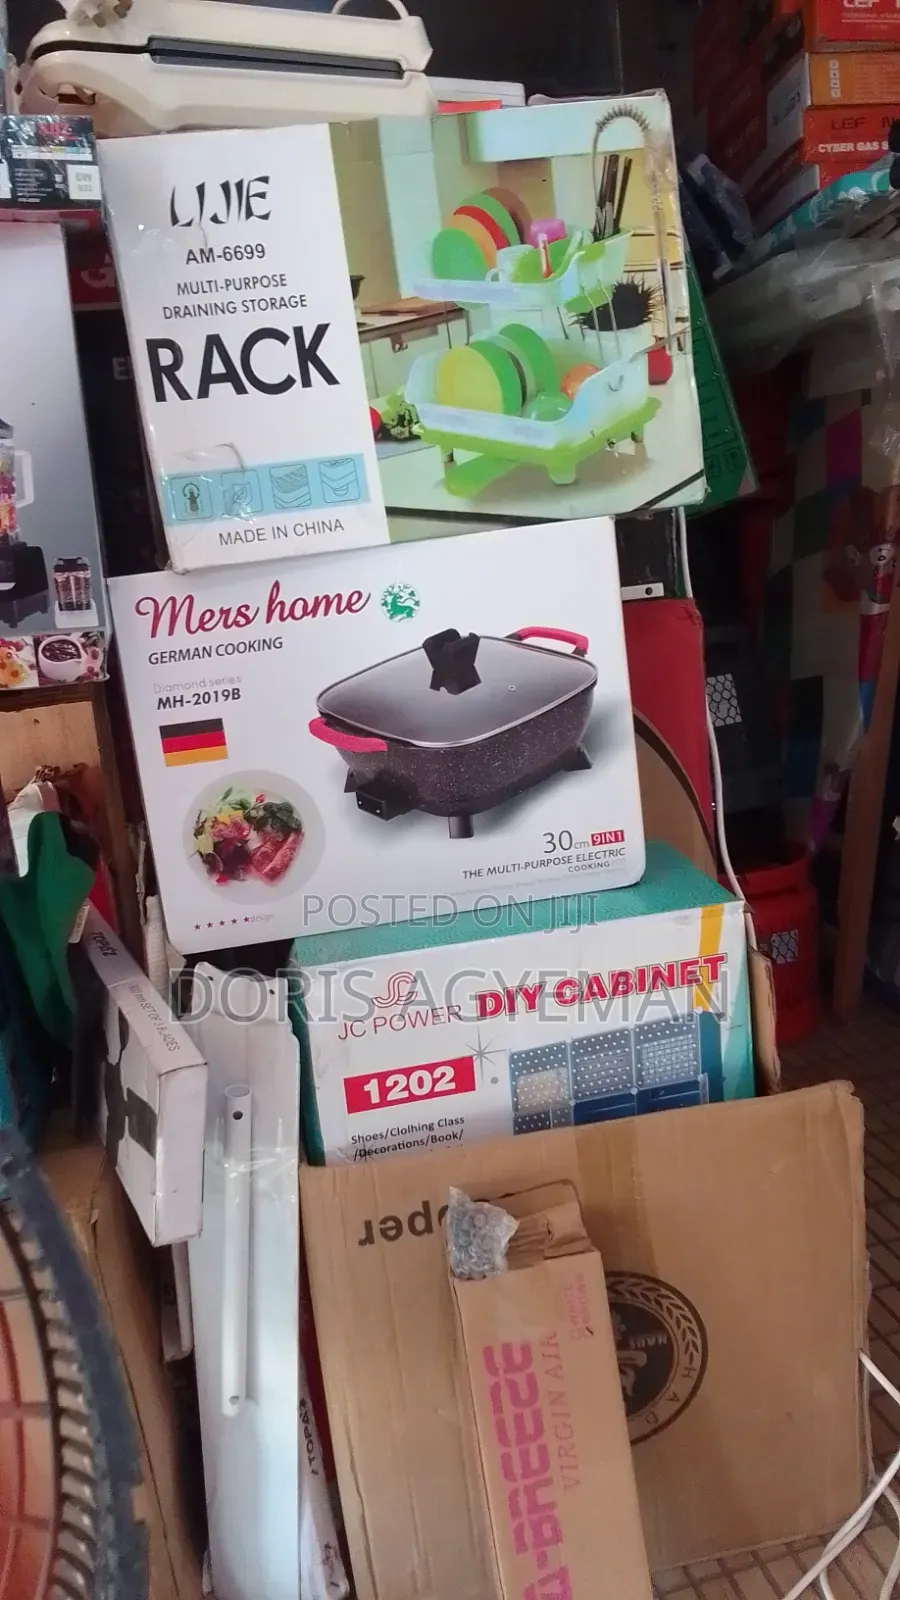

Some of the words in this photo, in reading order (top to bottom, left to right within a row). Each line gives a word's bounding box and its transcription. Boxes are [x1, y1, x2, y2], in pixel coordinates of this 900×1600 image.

[831, 117, 867, 130] LEF
[818, 142, 855, 153] CYBER
[856, 141, 880, 151] GAS
[185, 243, 266, 265] AM-6699
[177, 274, 288, 296] MULTI-PURPOSE
[163, 301, 237, 320] DRAINING
[241, 294, 308, 314] STORAGE
[146, 323, 341, 403] RACK
[219, 526, 267, 546] MADE
[271, 525, 289, 539] IN
[293, 517, 345, 538] CHINA
[135, 594, 259, 639] Mers
[265, 580, 371, 624] home
[148, 645, 213, 666] GERMAN
[215, 636, 284, 657] COOKING
[152, 678, 207, 695] Diamond
[209, 675, 242, 688] series
[156, 688, 242, 711] MH-2019B
[463, 868, 484, 880] THE
[487, 855, 574, 877] MULTI-PURPOSE
[576, 847, 626, 864] ELECTRIC
[568, 860, 611, 874] COOKING
[475, 981, 545, 1020] DIY
[553, 952, 728, 1007] CABINET
[338, 1019, 366, 1041] JC
[373, 1004, 463, 1035] POWER
[363, 1065, 456, 1104] 1202
[437, 1116, 465, 1129] Class
[539, 1330, 565, 1381] AIR
[549, 1390, 581, 1494] VIRGIN
